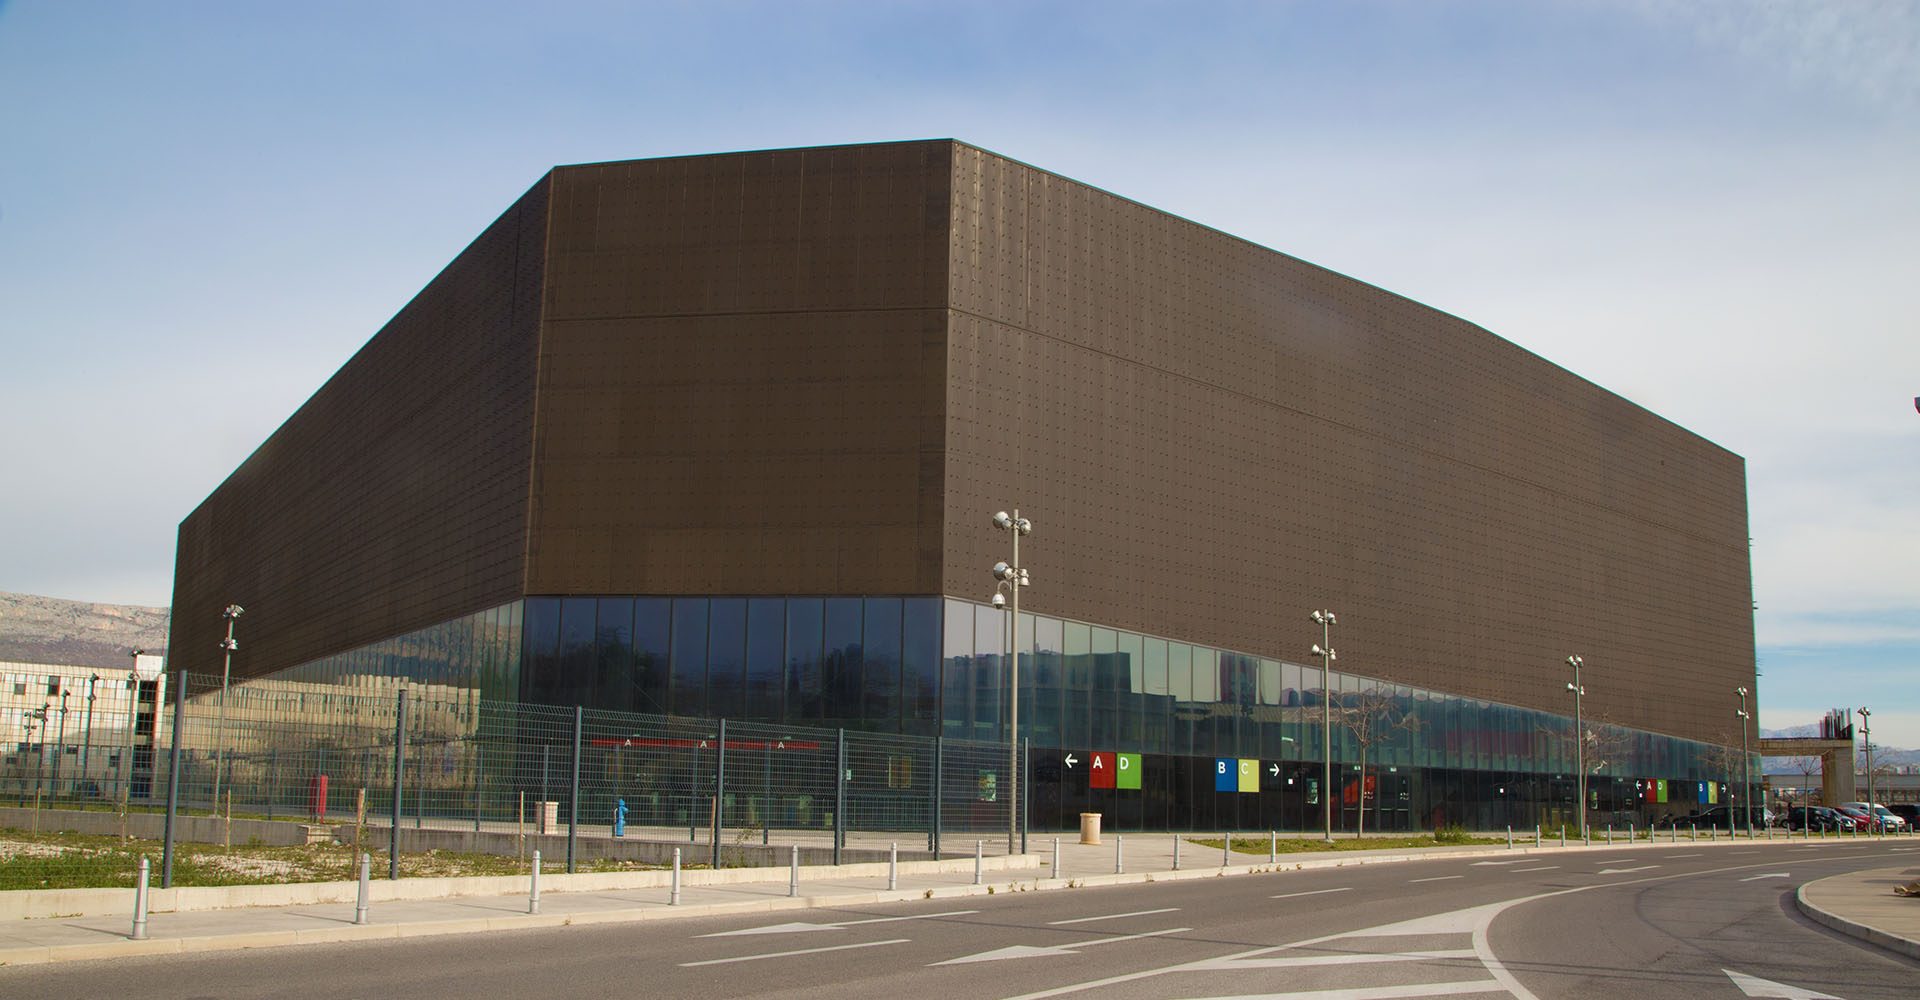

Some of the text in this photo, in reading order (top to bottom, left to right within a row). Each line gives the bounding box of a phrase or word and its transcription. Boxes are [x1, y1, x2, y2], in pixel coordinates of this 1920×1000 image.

[624, 739, 784, 749] A A A
[1093, 755, 1129, 770] A D
[1218, 761, 1248, 775] B C
[1646, 781, 1663, 791] A D
